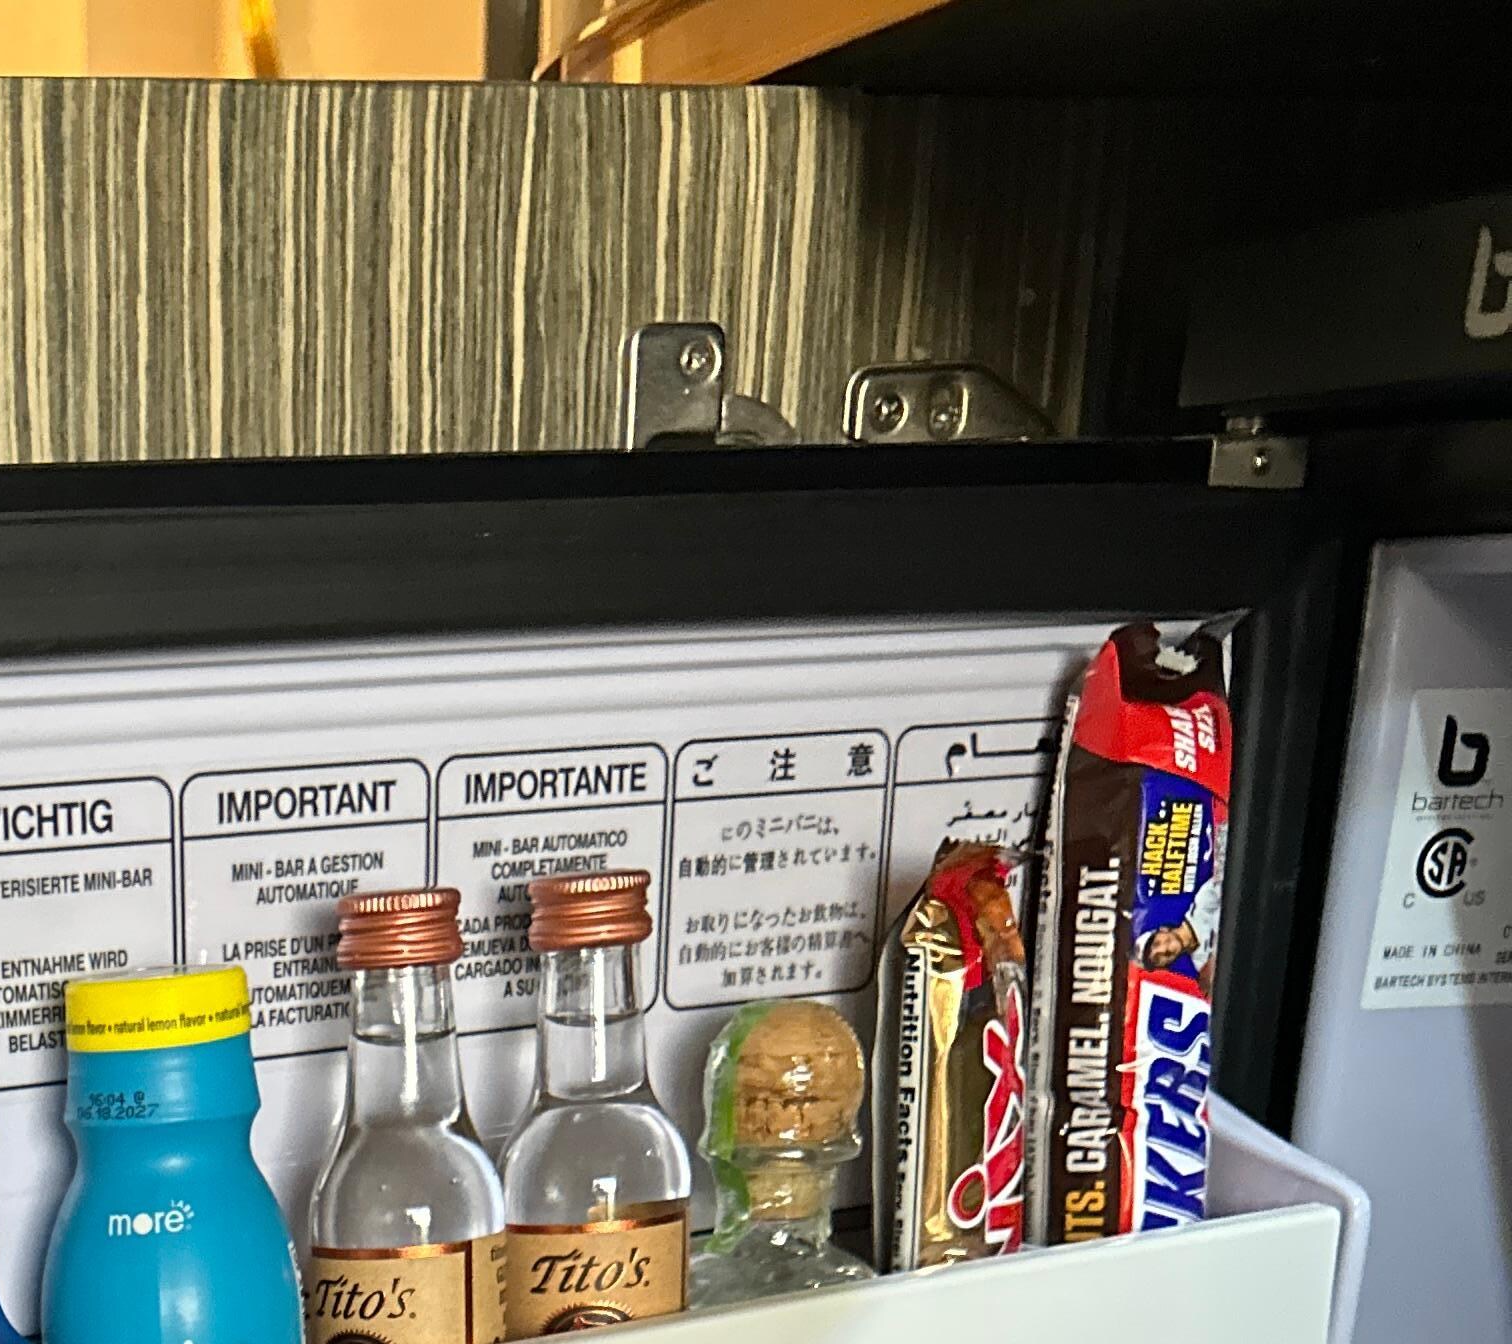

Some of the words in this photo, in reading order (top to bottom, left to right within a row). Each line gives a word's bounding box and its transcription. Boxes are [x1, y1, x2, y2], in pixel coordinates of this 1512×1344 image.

[465, 762, 648, 805] IMPORTANTE
[217, 779, 397, 824] IMPORTANT
[1411, 790, 1505, 813] bartech
[473, 840, 502, 859] MINI
[512, 836, 539, 856] BAR
[542, 830, 627, 853] AUTOMATICO
[1141, 822, 1169, 876] HACK
[1160, 801, 1194, 895] HALFTIME
[83, 868, 153, 893] MINI-BAR
[232, 863, 263, 882] MINI
[275, 857, 304, 880] BAR
[308, 858, 318, 874] A
[321, 851, 384, 875] GESTION
[491, 854, 608, 880] COMPLETAMENTE
[256, 879, 359, 905] AUTOMATIQUE
[1071, 857, 1122, 1004] NOUGAT.
[223, 943, 241, 962] LA
[244, 938, 287, 961] PRISE
[291, 934, 323, 955] D'UN
[1383, 945, 1414, 959] MADE
[1423, 944, 1437, 958] IN
[1443, 943, 1482, 958] CHINA
[1, 953, 85, 980] ENTNAHME
[89, 949, 128, 971] WIRD
[455, 956, 523, 981] CARGADO
[504, 982, 513, 998] A
[515, 979, 534, 997] SU
[114, 1018, 145, 1034] natural
[147, 1017, 177, 1033] lemon
[179, 1012, 206, 1028] flavor
[898, 950, 920, 1077] Nutrition
[1065, 1012, 1111, 1176] CARAMEL.
[894, 1086, 916, 1159] Facts
[108, 1209, 185, 1237] more
